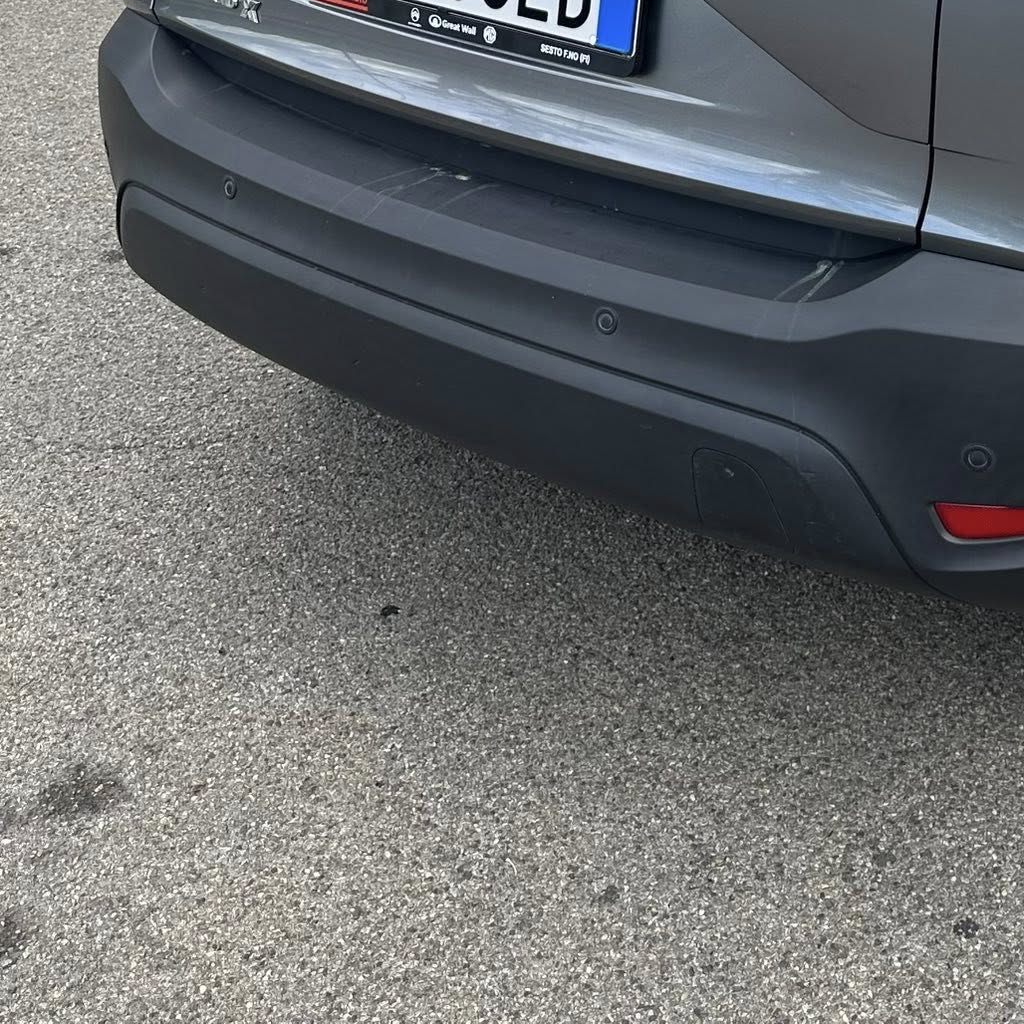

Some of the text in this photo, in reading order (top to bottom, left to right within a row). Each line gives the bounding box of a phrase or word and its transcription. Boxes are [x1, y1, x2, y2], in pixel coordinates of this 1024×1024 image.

[442, 19, 477, 36] Great Wall
[540, 43, 563, 57] SESTO
